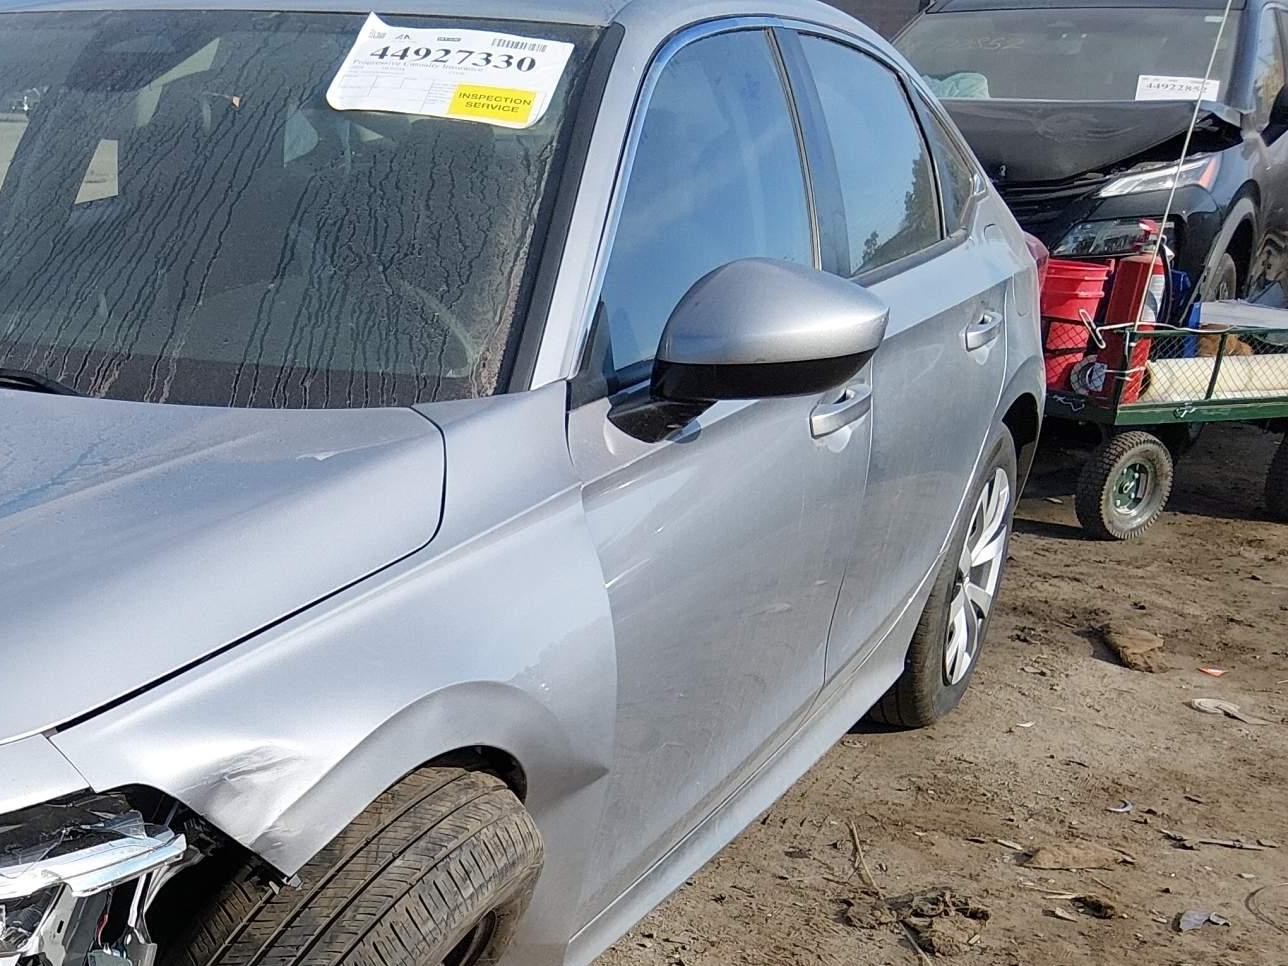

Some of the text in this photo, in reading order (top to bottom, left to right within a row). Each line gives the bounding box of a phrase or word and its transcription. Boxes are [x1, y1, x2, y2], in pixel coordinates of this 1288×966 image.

[369, 45, 537, 73] 44927330
[458, 91, 532, 107] INSPECTION
[464, 101, 520, 113] SERVICE
